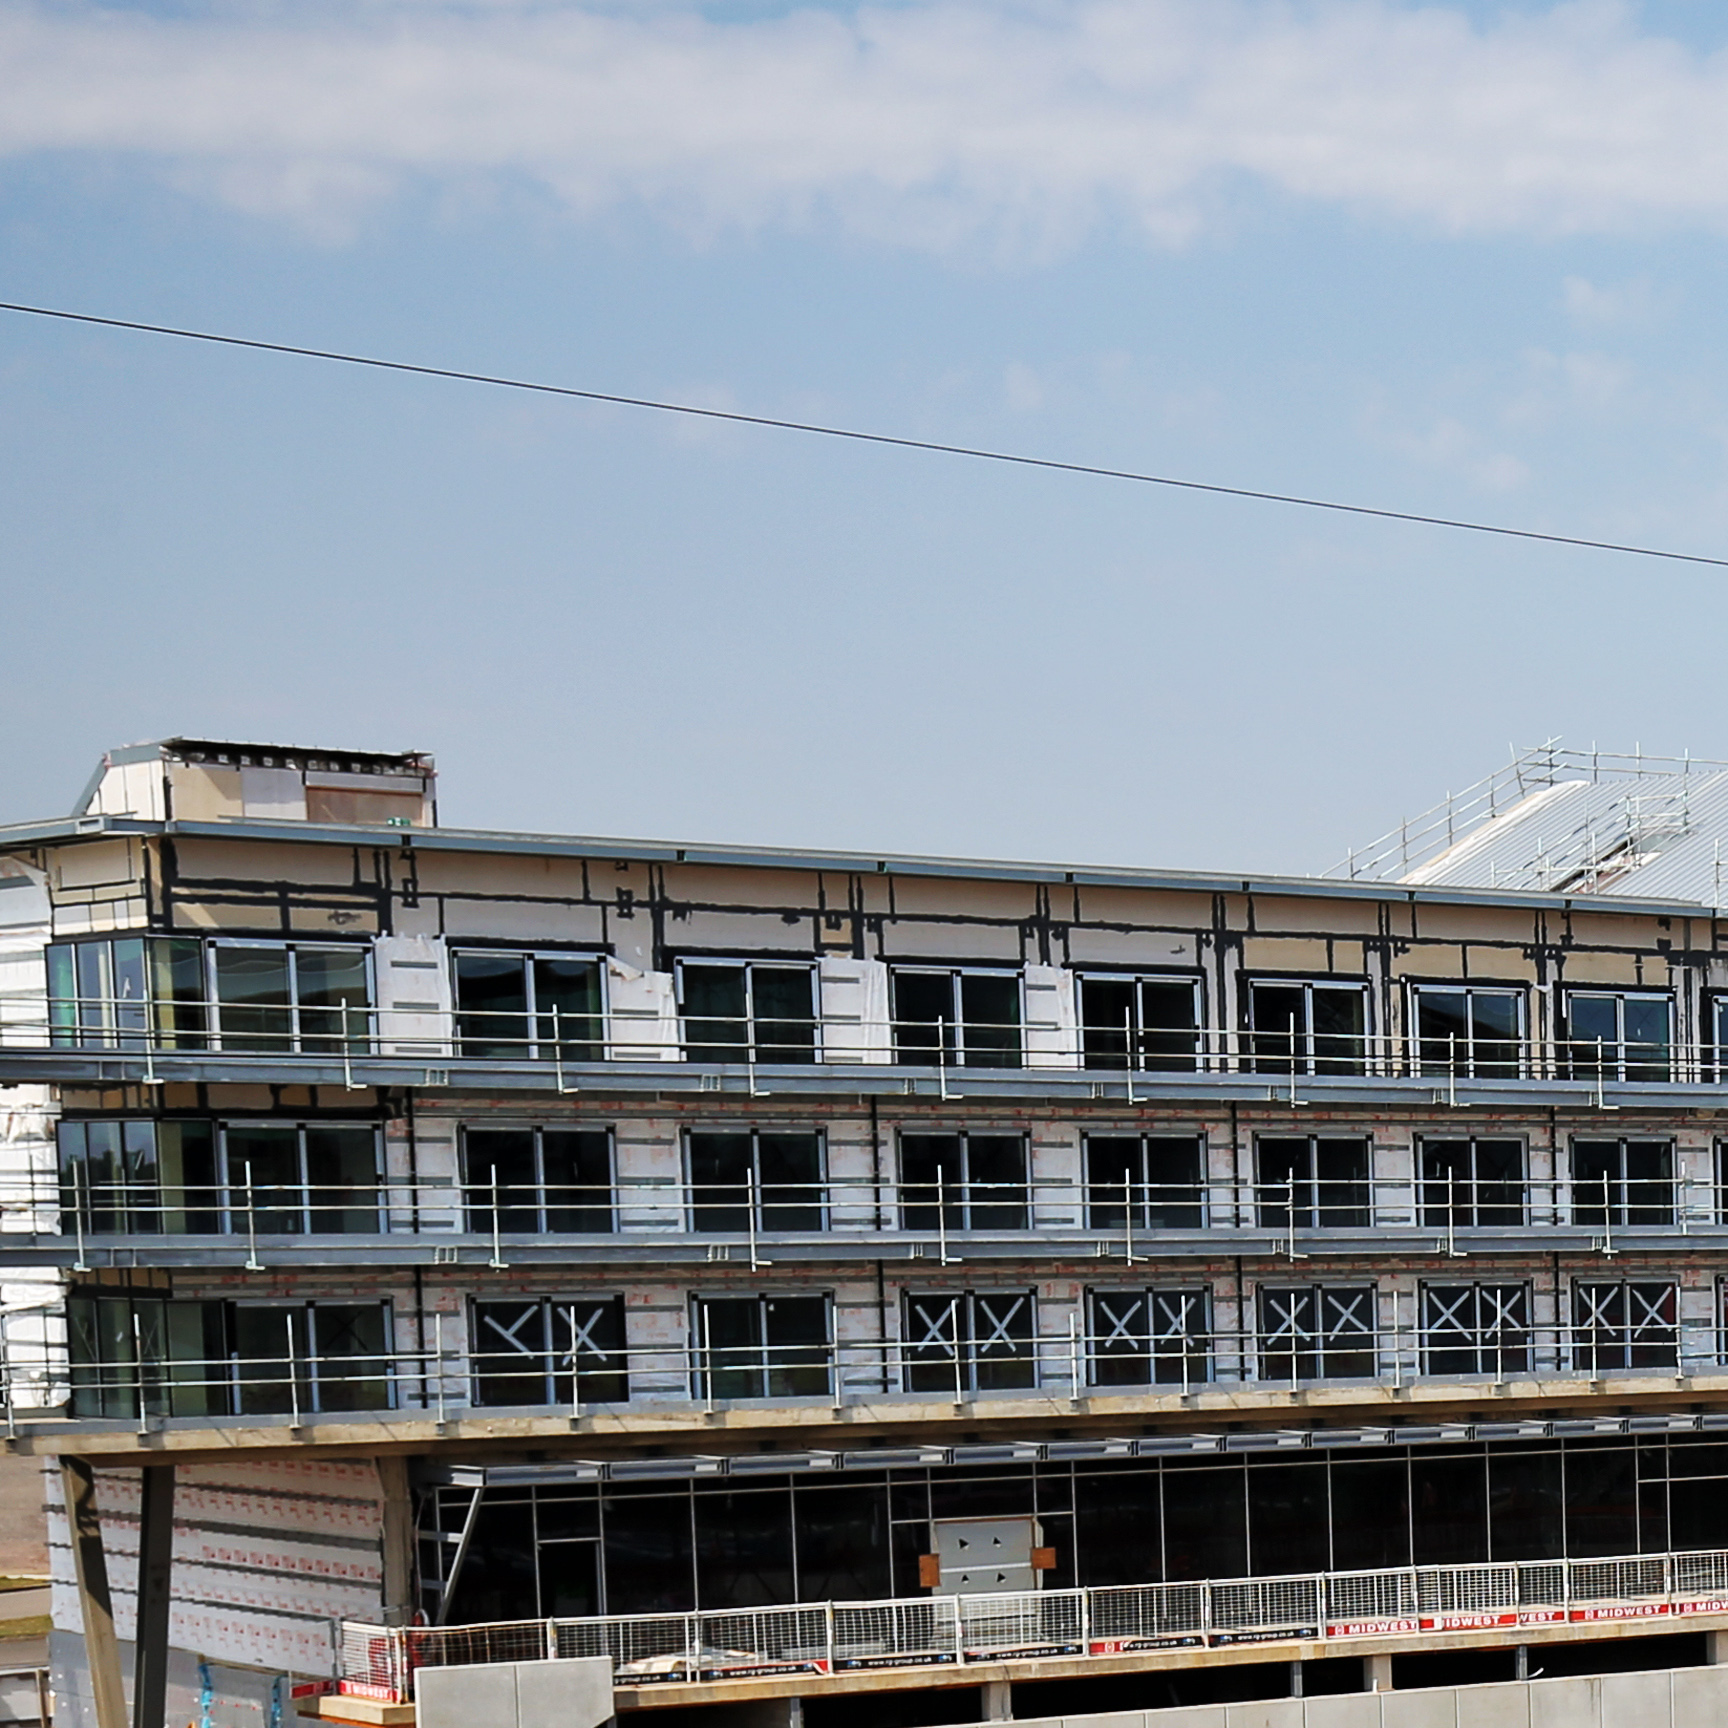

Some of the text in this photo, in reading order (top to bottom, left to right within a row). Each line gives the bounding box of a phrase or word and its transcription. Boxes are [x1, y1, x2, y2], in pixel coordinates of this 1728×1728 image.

[1597, 1605, 1661, 1618] MIDWEST
[1349, 1619, 1417, 1634] MIDWEST
[1443, 1616, 1500, 1628] IDWEST
